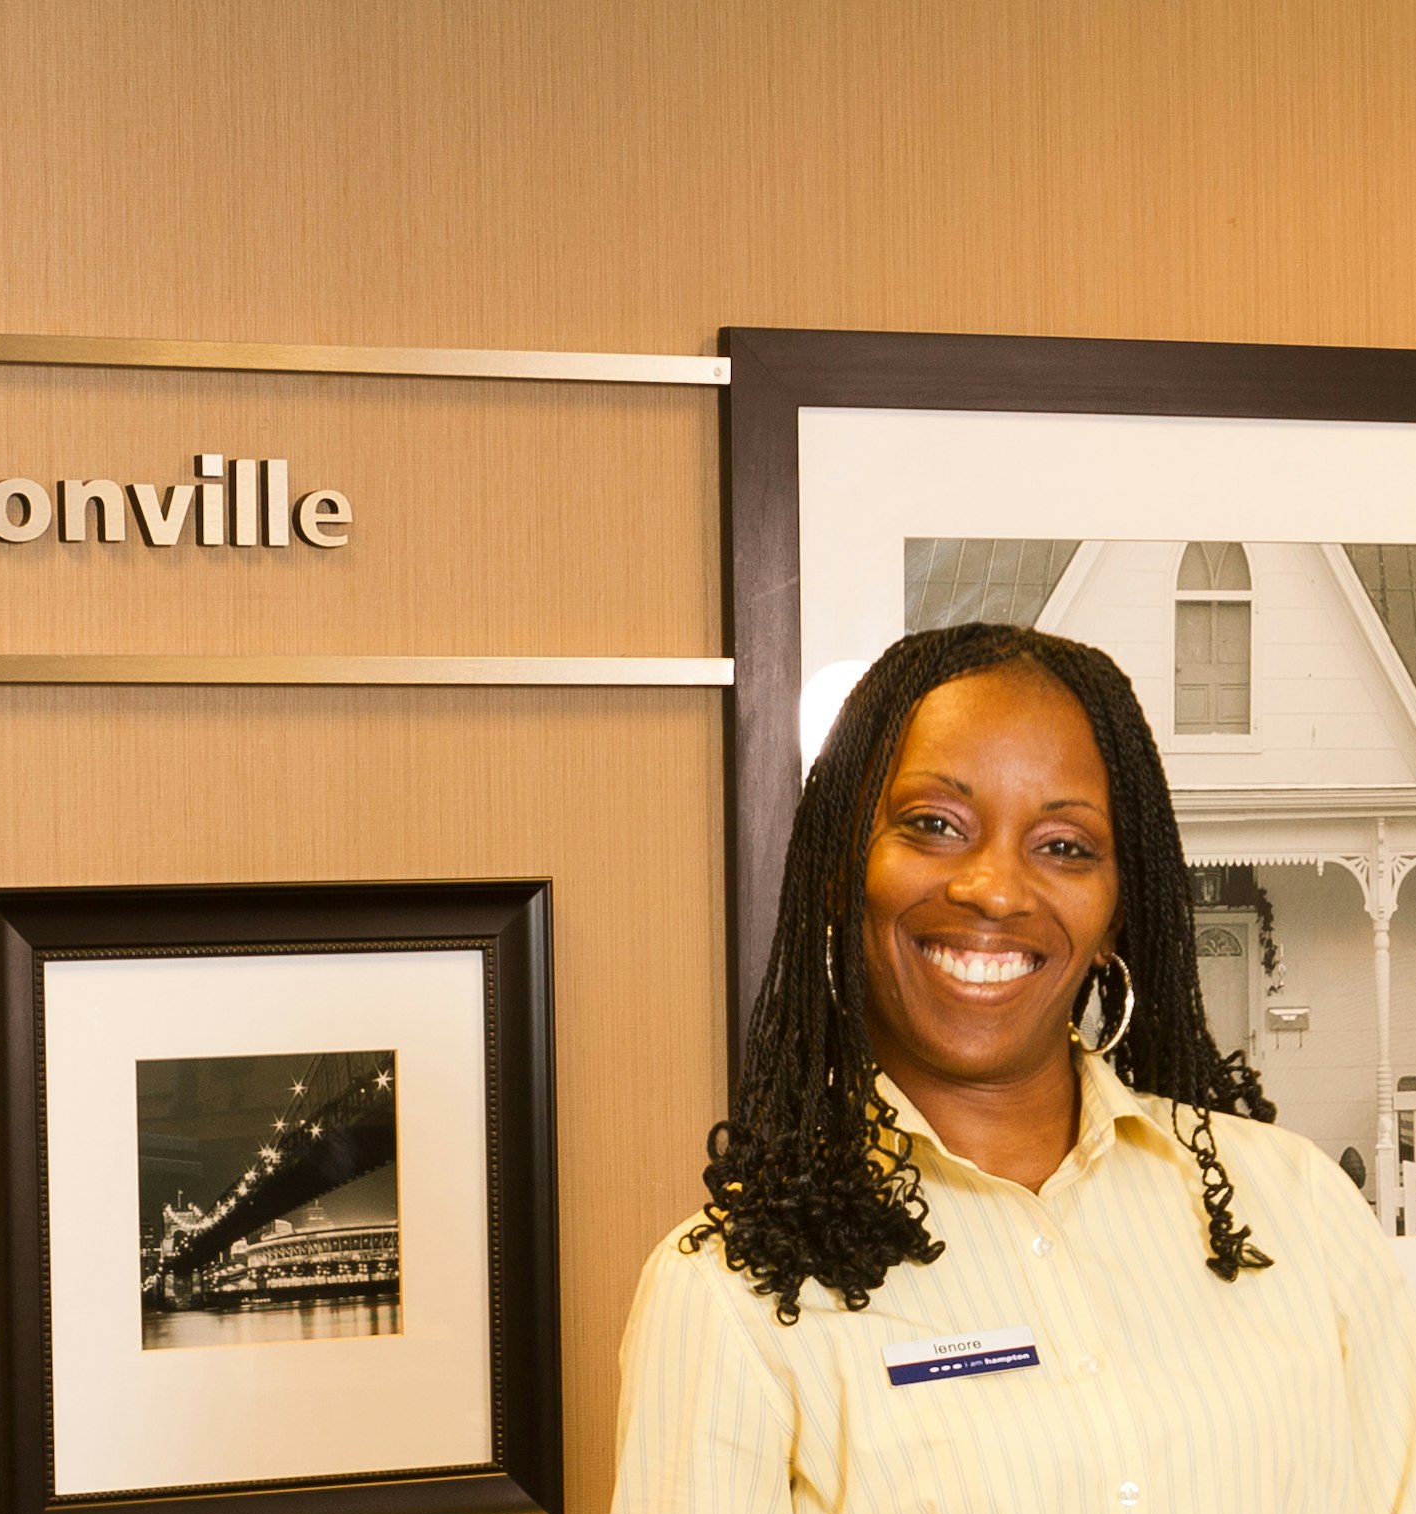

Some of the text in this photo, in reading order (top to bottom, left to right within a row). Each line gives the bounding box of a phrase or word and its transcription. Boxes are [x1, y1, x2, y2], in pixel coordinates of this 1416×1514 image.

[933, 1340, 982, 1355] lenore
[970, 1360, 983, 1368] am
[984, 1353, 1030, 1366] hampton
